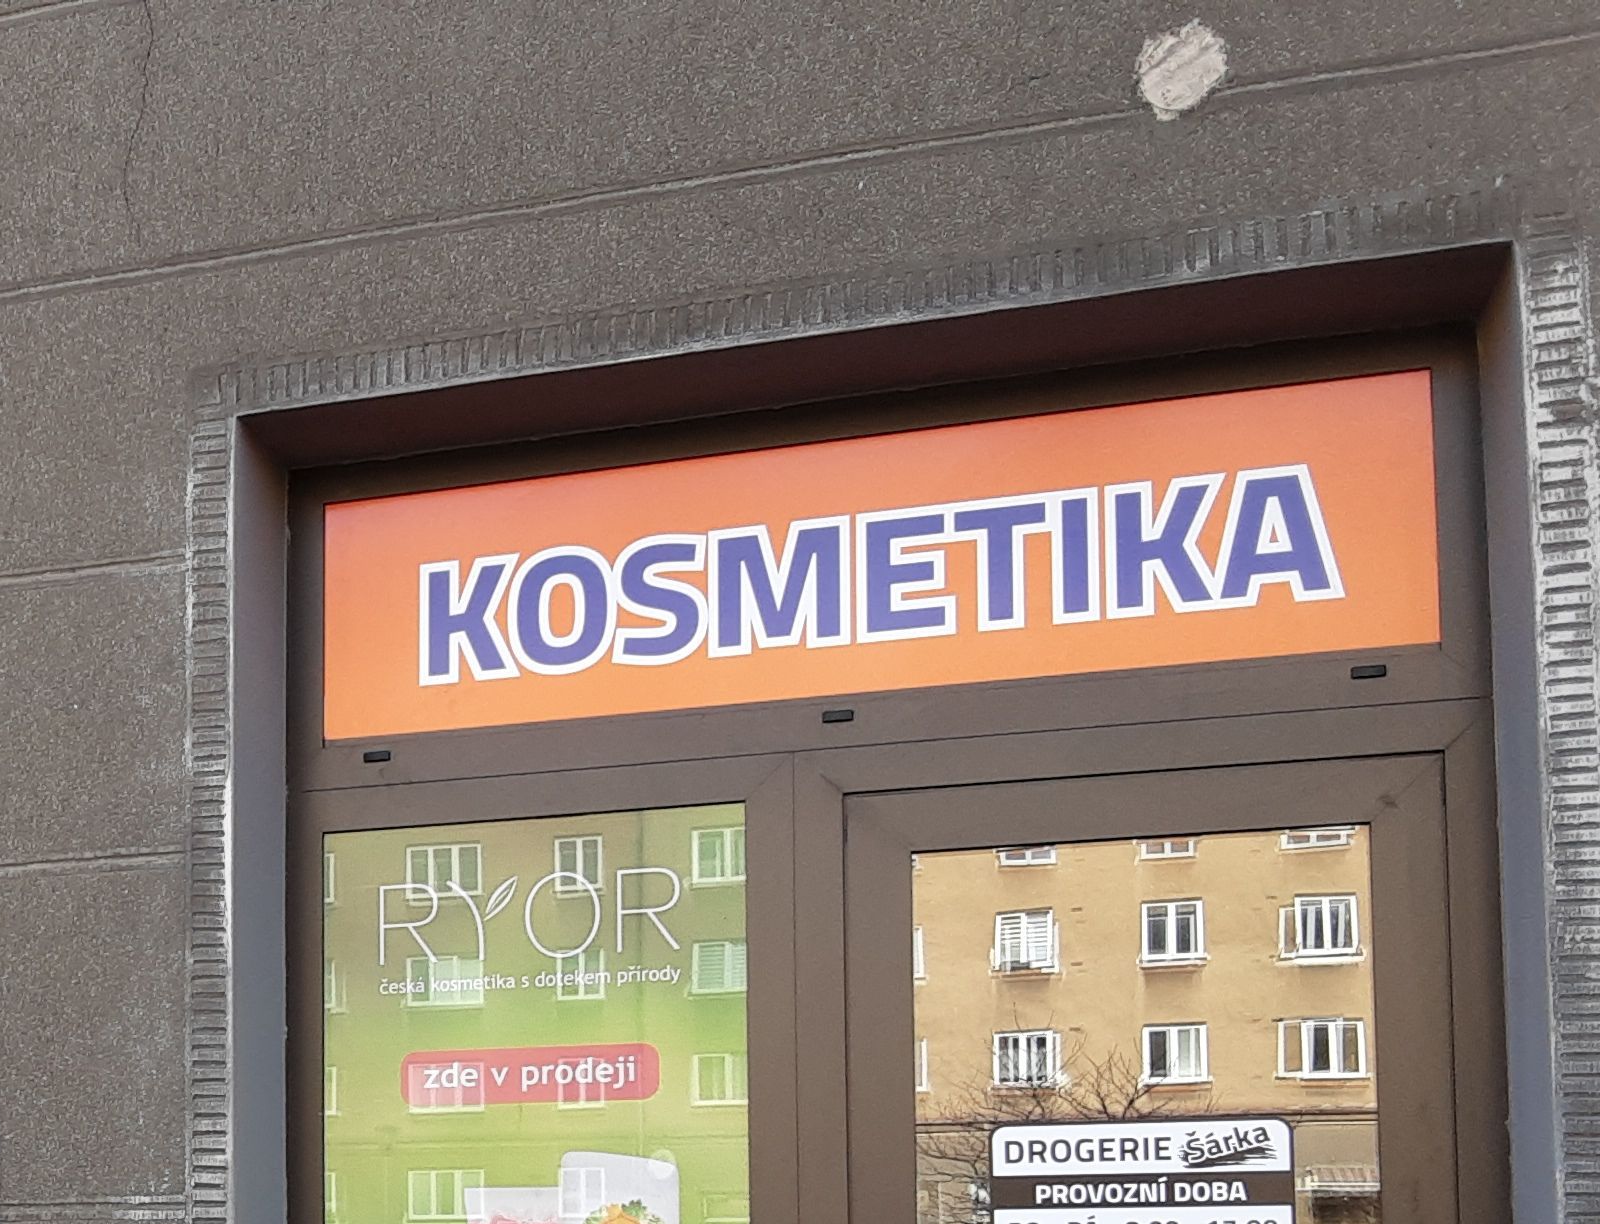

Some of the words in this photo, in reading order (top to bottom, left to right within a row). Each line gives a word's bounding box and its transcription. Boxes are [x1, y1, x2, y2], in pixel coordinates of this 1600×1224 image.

[418, 462, 1346, 687] KOSMETIKA
[379, 867, 681, 966] RYOR
[379, 977, 425, 995] česká
[431, 973, 516, 993] kosmetika
[520, 976, 530, 989] s
[535, 970, 611, 988] dotekem
[617, 965, 681, 986] přírody
[423, 1062, 479, 1089] zde
[492, 1067, 508, 1087] v
[520, 1055, 636, 1092] prodeji
[1004, 1136, 1172, 1164] DROGERIE
[1184, 1125, 1271, 1163] Šárka
[1035, 1177, 1168, 1205] PROVOZNÍ
[1174, 1181, 1248, 1202] DOBA
